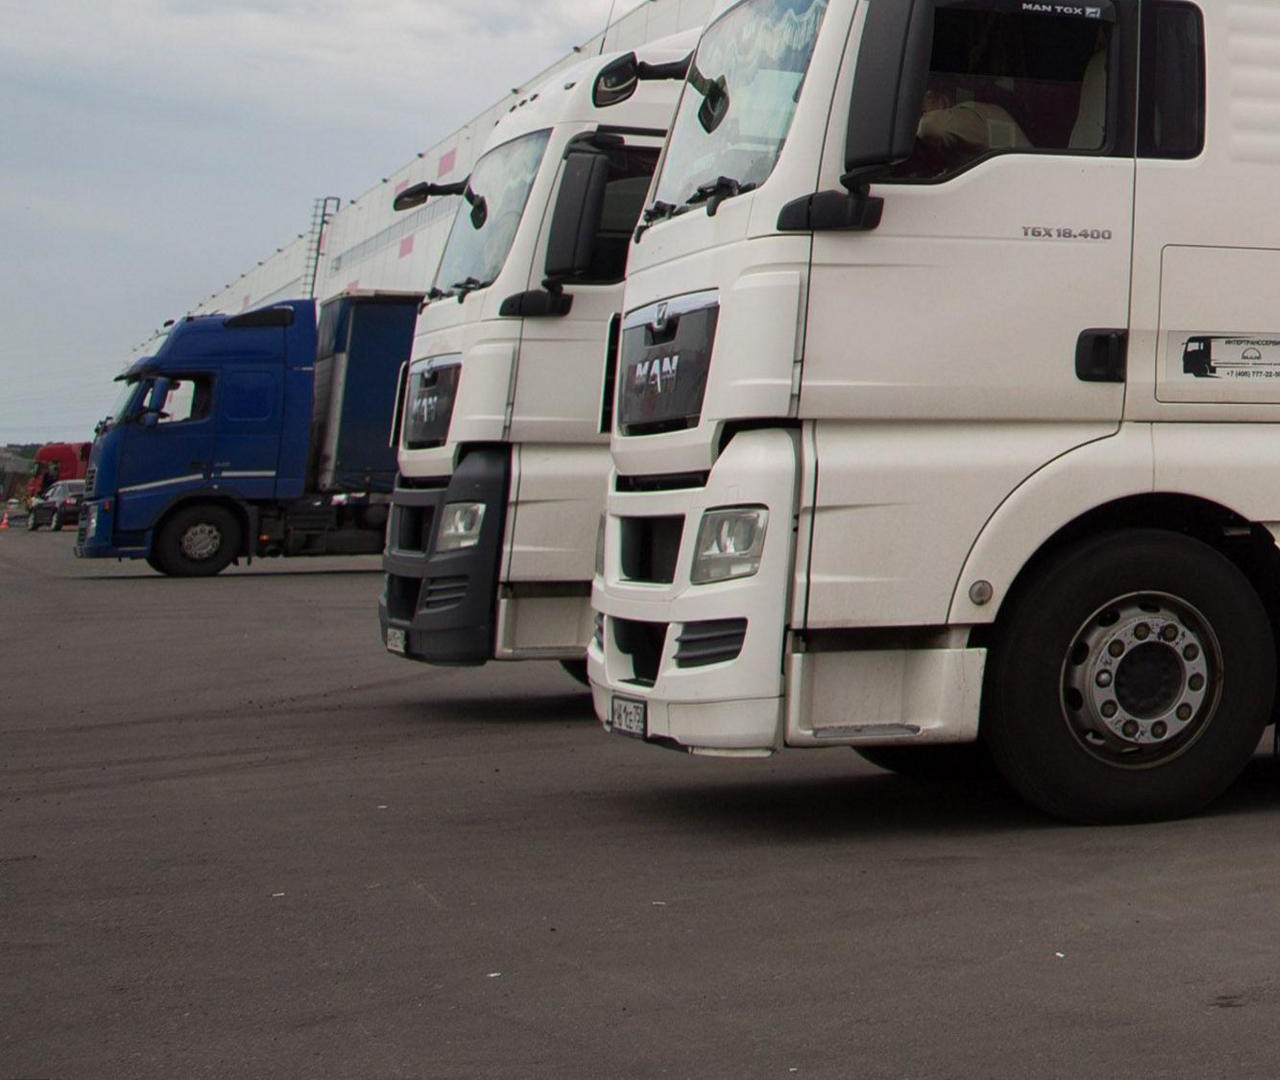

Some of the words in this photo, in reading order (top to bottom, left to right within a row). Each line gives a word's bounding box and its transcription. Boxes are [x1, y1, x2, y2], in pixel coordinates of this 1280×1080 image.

[1022, 3, 1052, 12] MAN
[1054, 6, 1082, 15] TGX
[1022, 226, 1053, 238] TGX
[1055, 227, 1112, 240] 18.400
[634, 354, 679, 393] MAN
